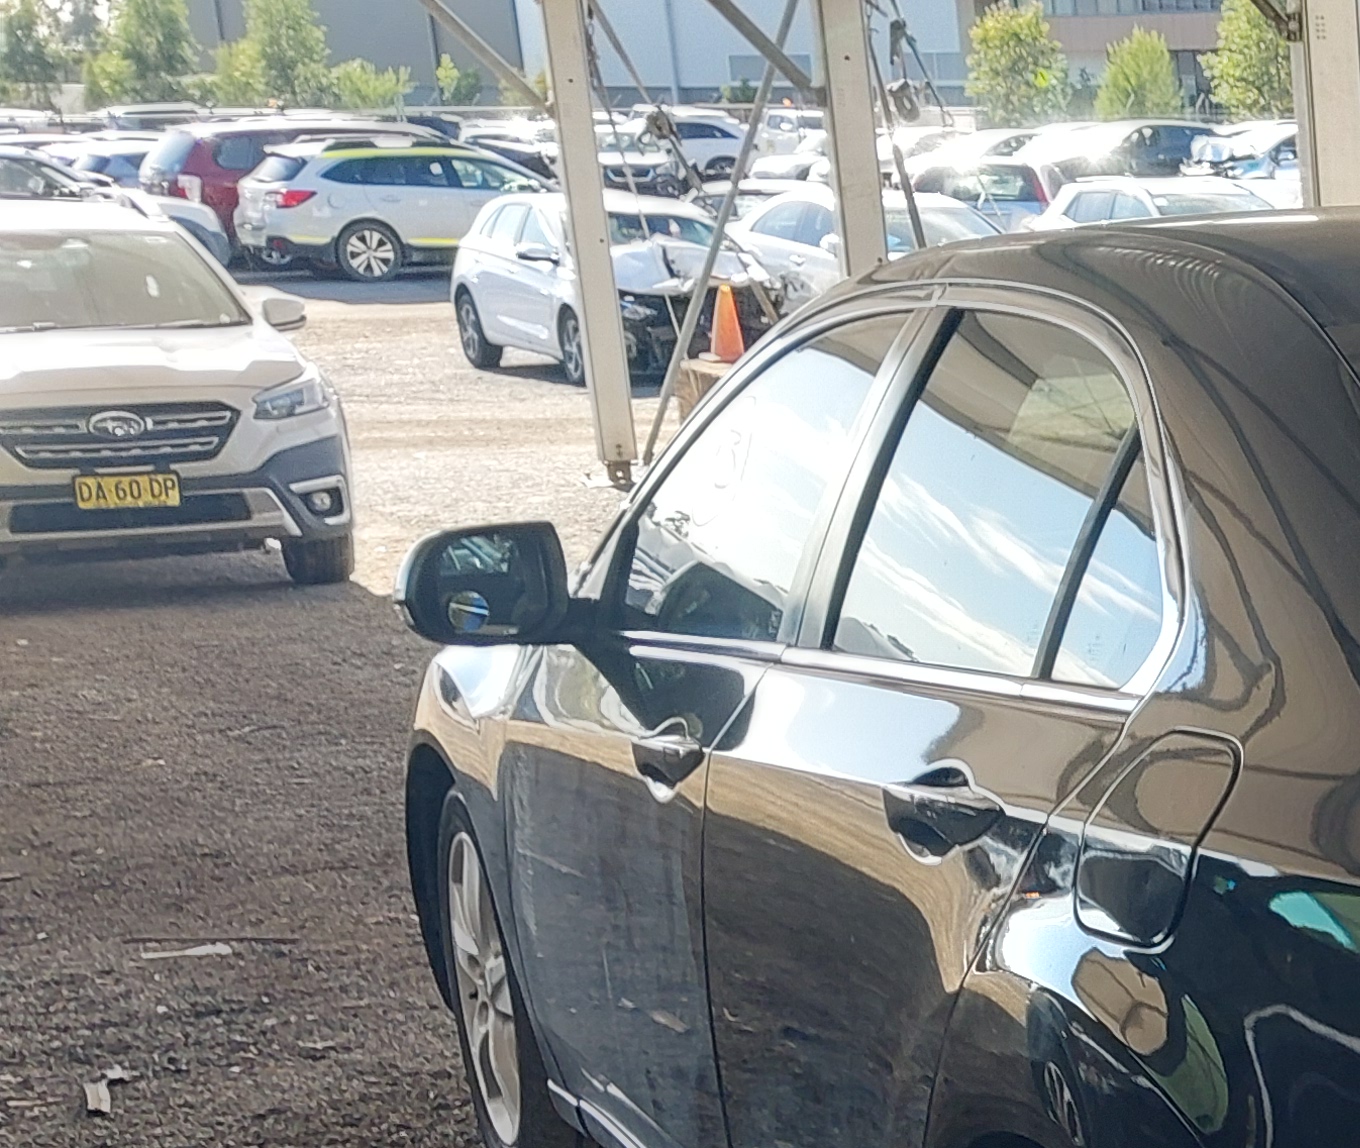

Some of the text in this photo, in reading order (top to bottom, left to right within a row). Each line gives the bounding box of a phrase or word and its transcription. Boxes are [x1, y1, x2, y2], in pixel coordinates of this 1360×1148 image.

[79, 477, 176, 502] DA 60 DP
